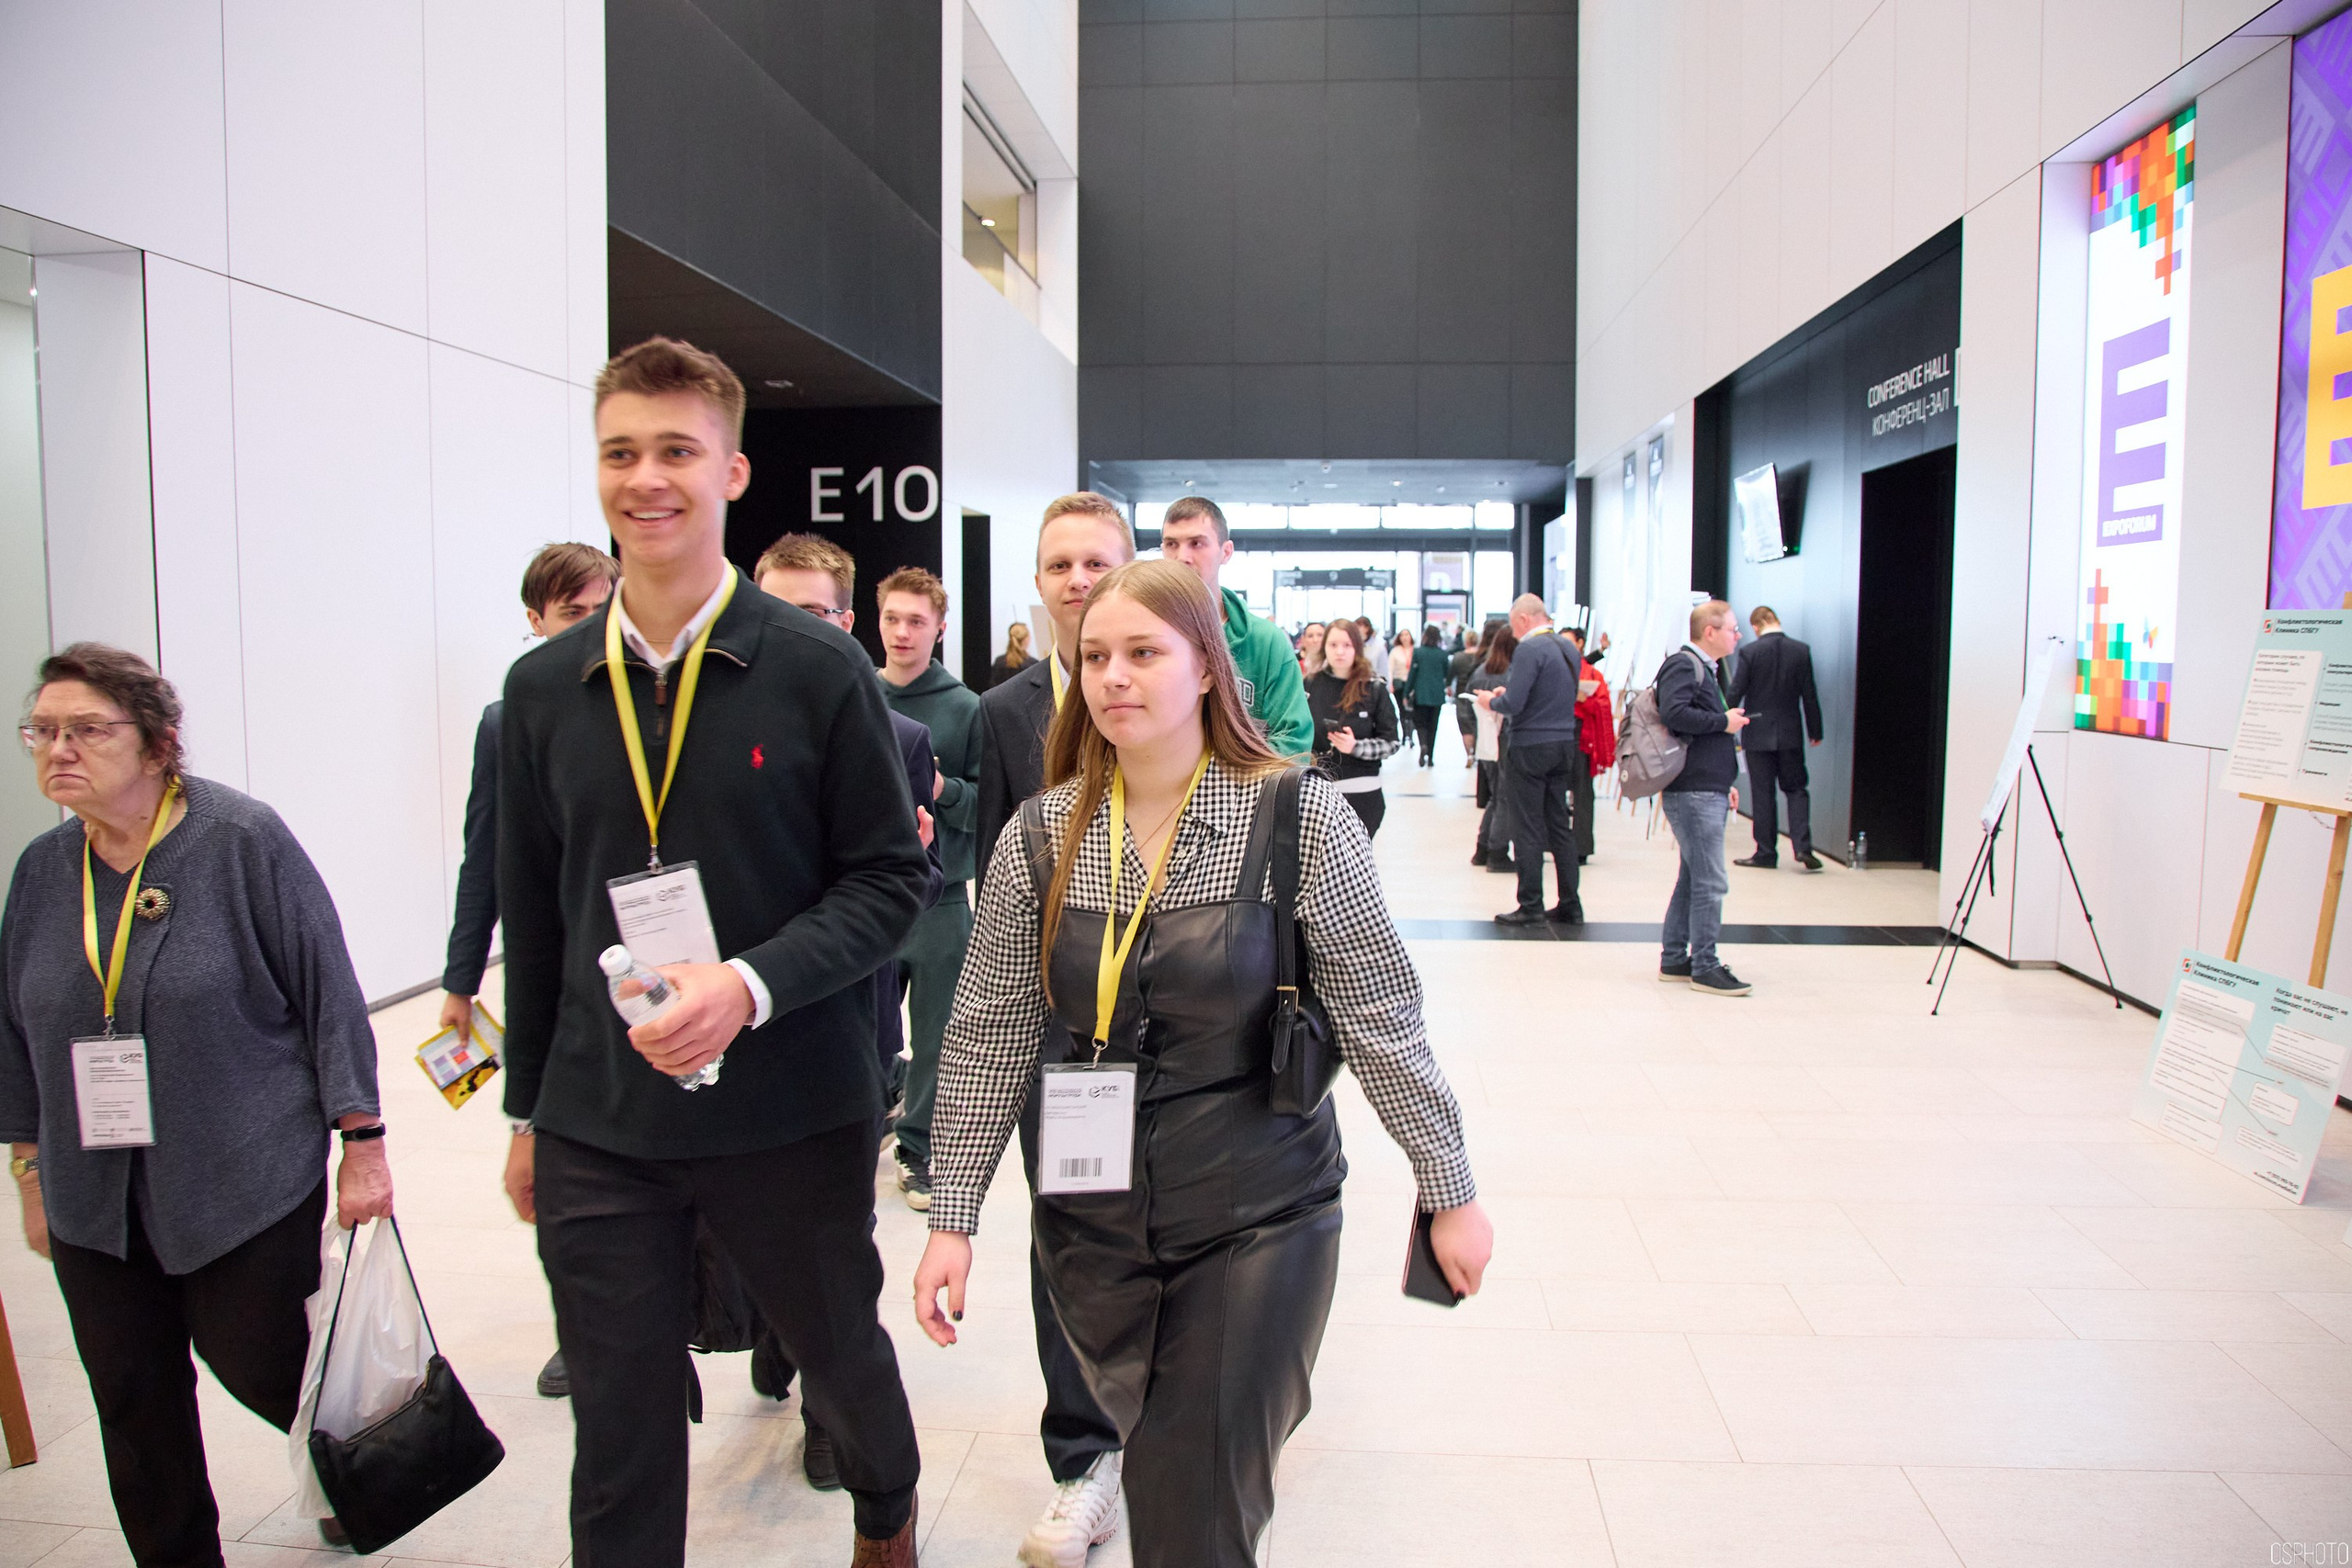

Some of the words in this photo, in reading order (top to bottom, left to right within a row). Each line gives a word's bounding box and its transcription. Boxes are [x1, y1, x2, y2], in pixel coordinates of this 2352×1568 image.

[1867, 364, 1923, 409] CONFERENCE
[1923, 353, 1951, 385] HALL
[1871, 387, 1950, 437] КОНФЕРЕНЦ-ЗАЛ
[2193, 969, 2218, 984] Клиника
[2195, 960, 2260, 987] Конфликтологическая
[2276, 987, 2292, 998] Когда
